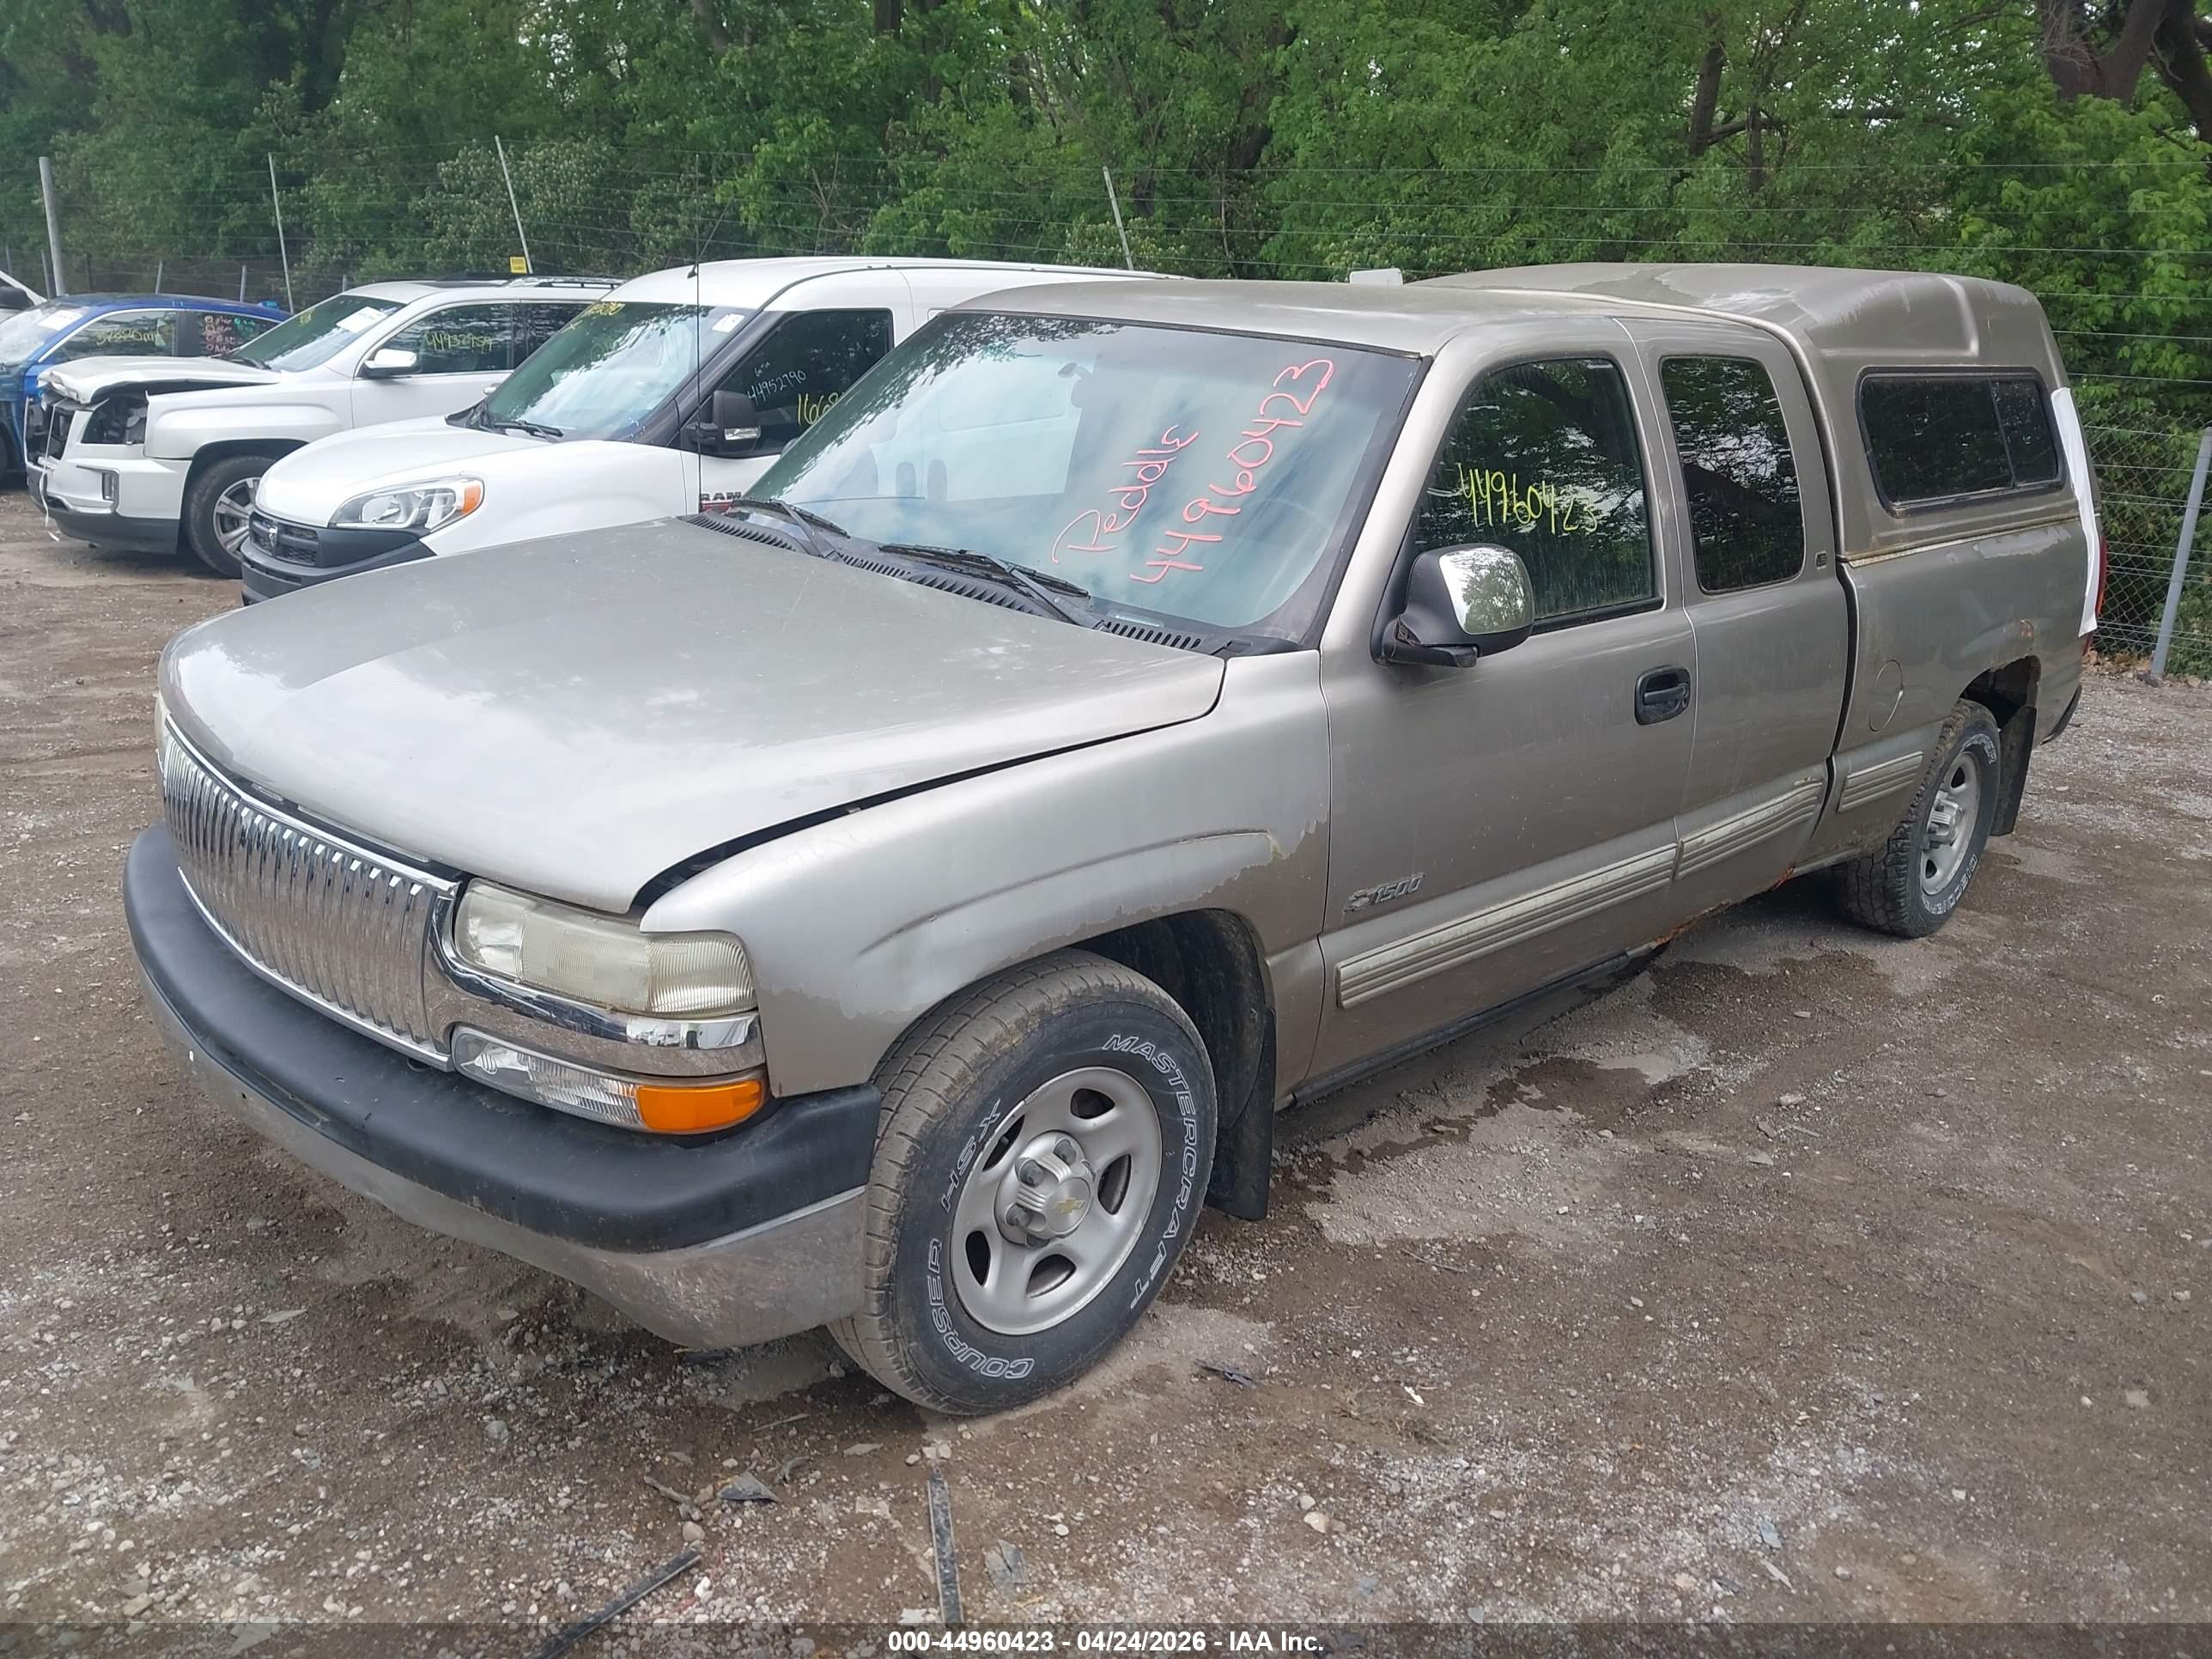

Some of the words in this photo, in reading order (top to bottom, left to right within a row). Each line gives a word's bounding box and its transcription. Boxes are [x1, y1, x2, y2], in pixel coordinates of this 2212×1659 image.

[747, 370, 806, 404] 44952790
[701, 491, 742, 501] RAM
[1129, 359, 1334, 584] 44960423
[941, 1098, 1001, 1214] HSX
[1102, 1034, 1198, 1310] MASTERCRAFT
[927, 1237, 1035, 1379] COURSER
